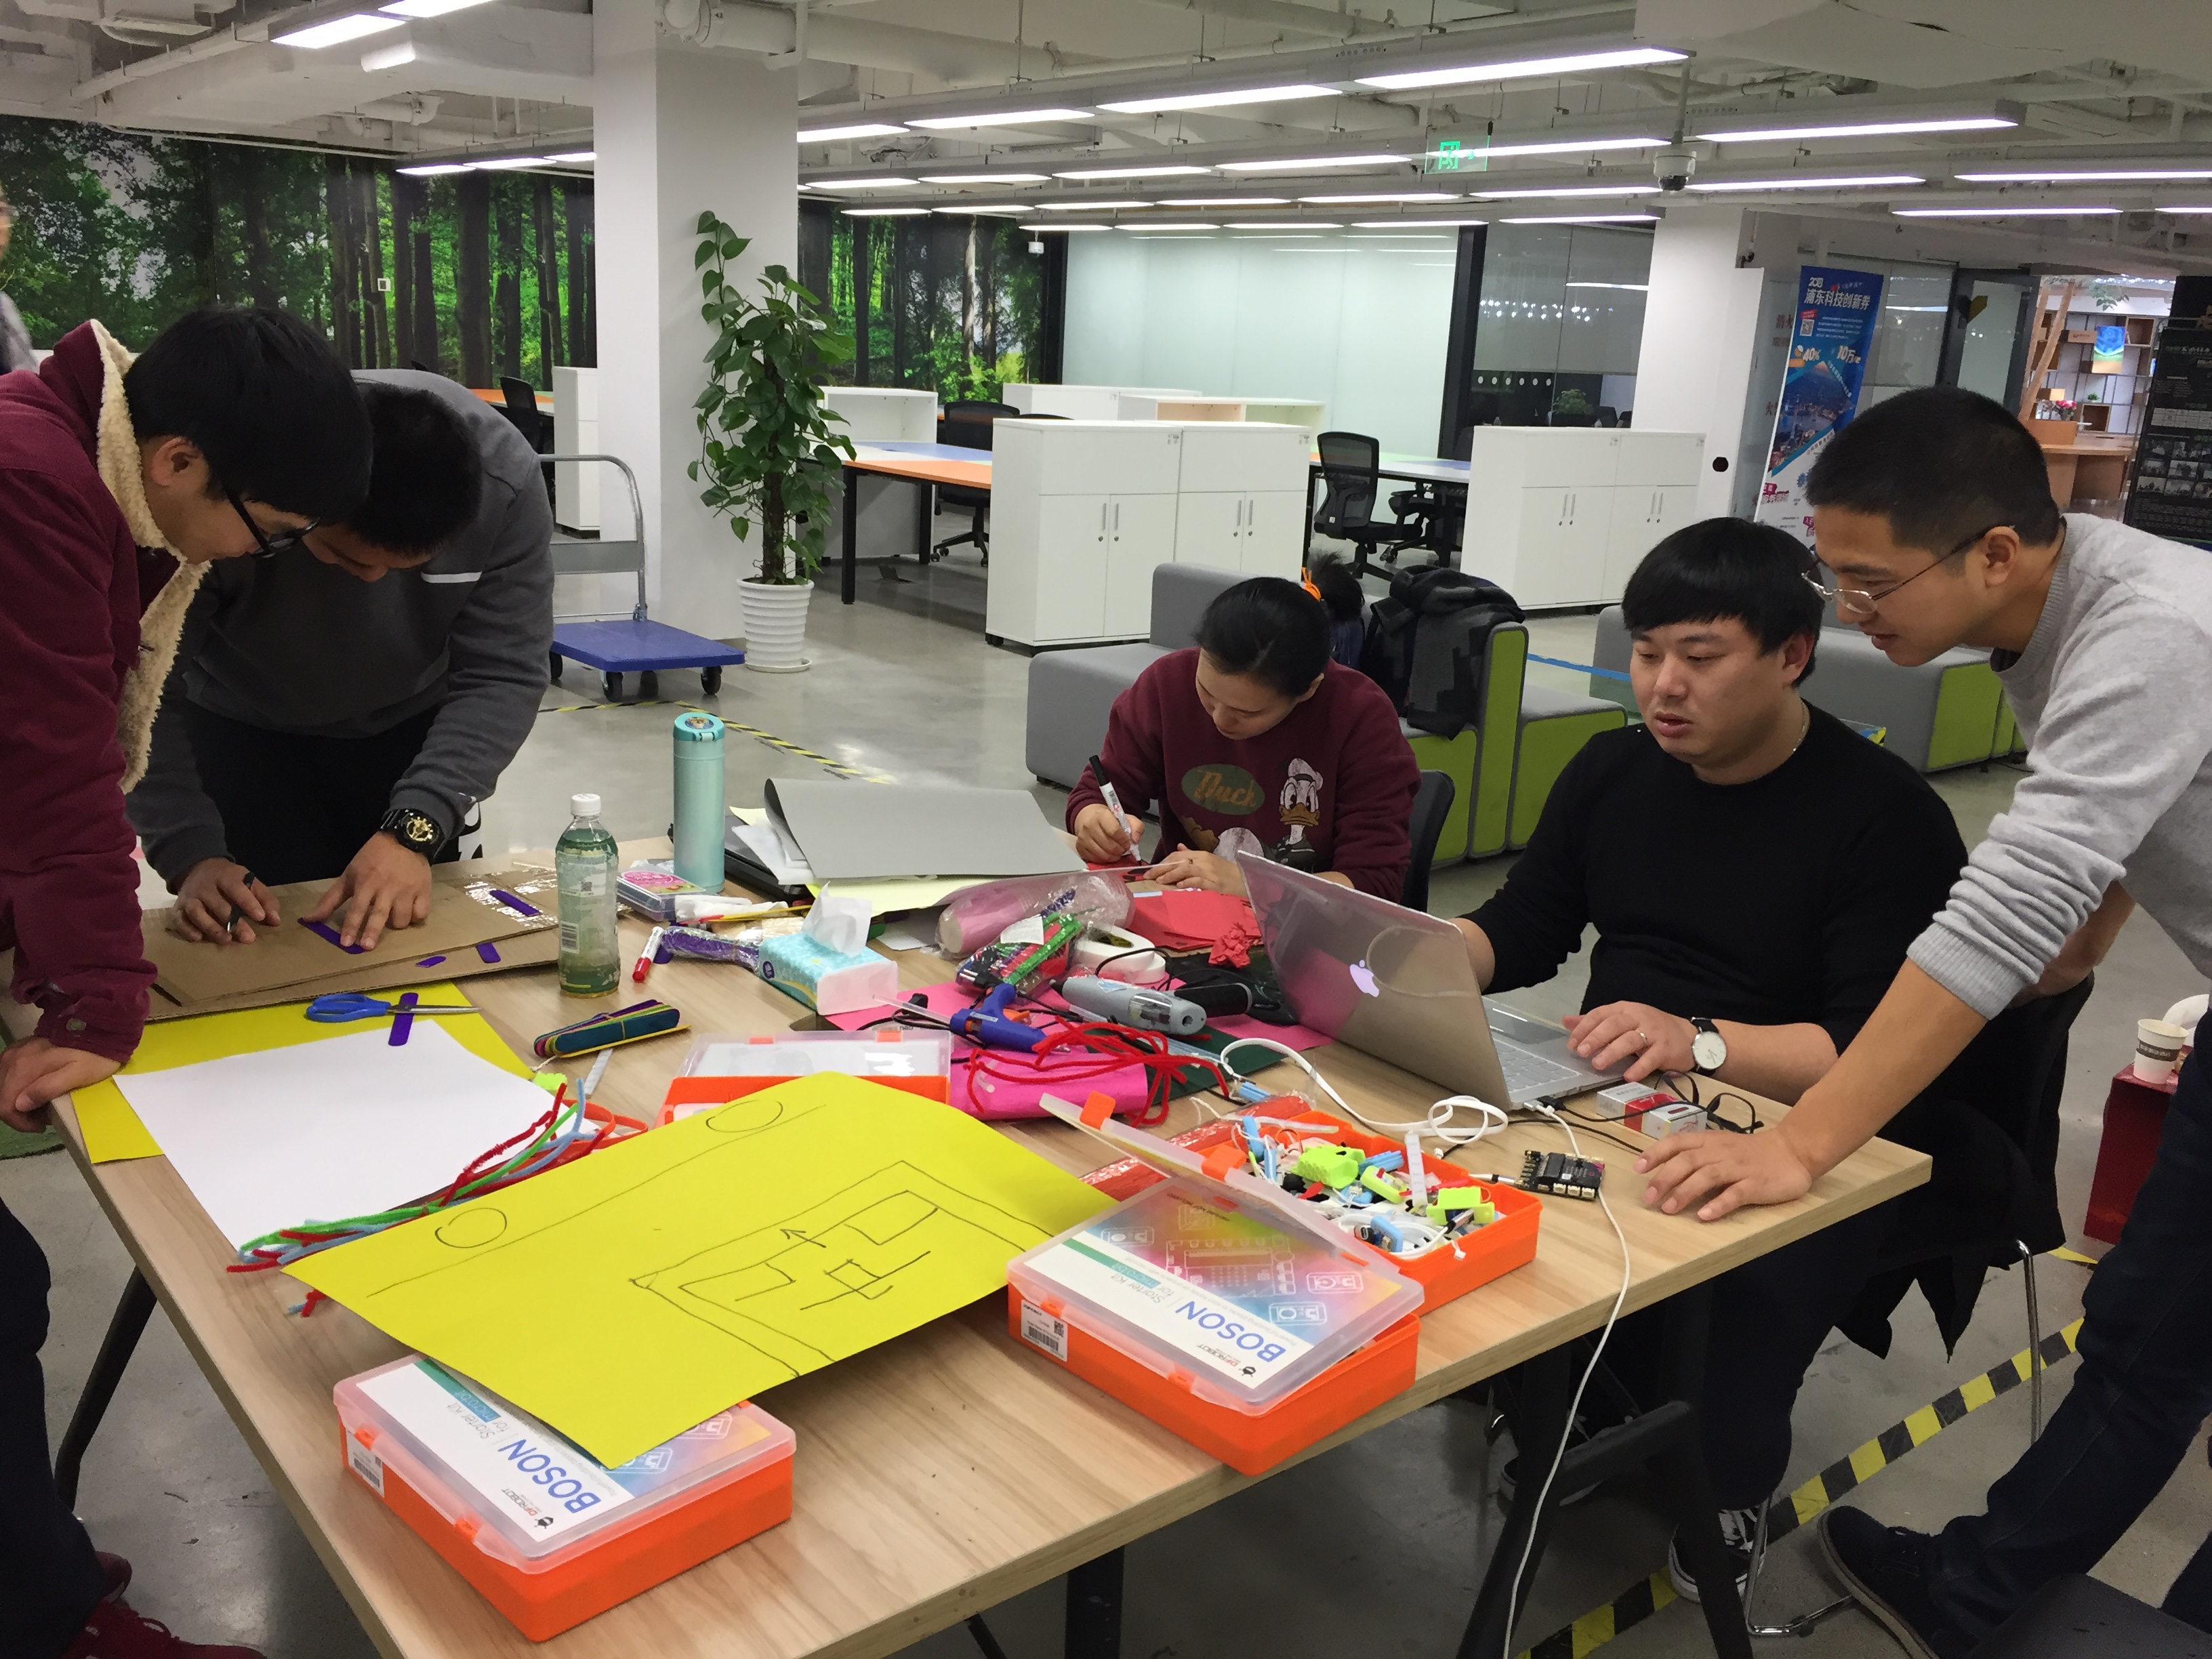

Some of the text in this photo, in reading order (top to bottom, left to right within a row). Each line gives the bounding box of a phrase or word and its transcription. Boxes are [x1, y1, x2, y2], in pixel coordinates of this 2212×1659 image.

[1194, 769, 1256, 807] Duck
[1111, 1274, 1166, 1304] Starter Kit
[1157, 1286, 1175, 1297] for
[1175, 1300, 1286, 1362] BOSON
[446, 1401, 464, 1415] Kit
[461, 1412, 495, 1439] Starter
[493, 1420, 510, 1433] for
[497, 1439, 601, 1513] BOSON
[501, 1488, 537, 1517] DFROBOT
